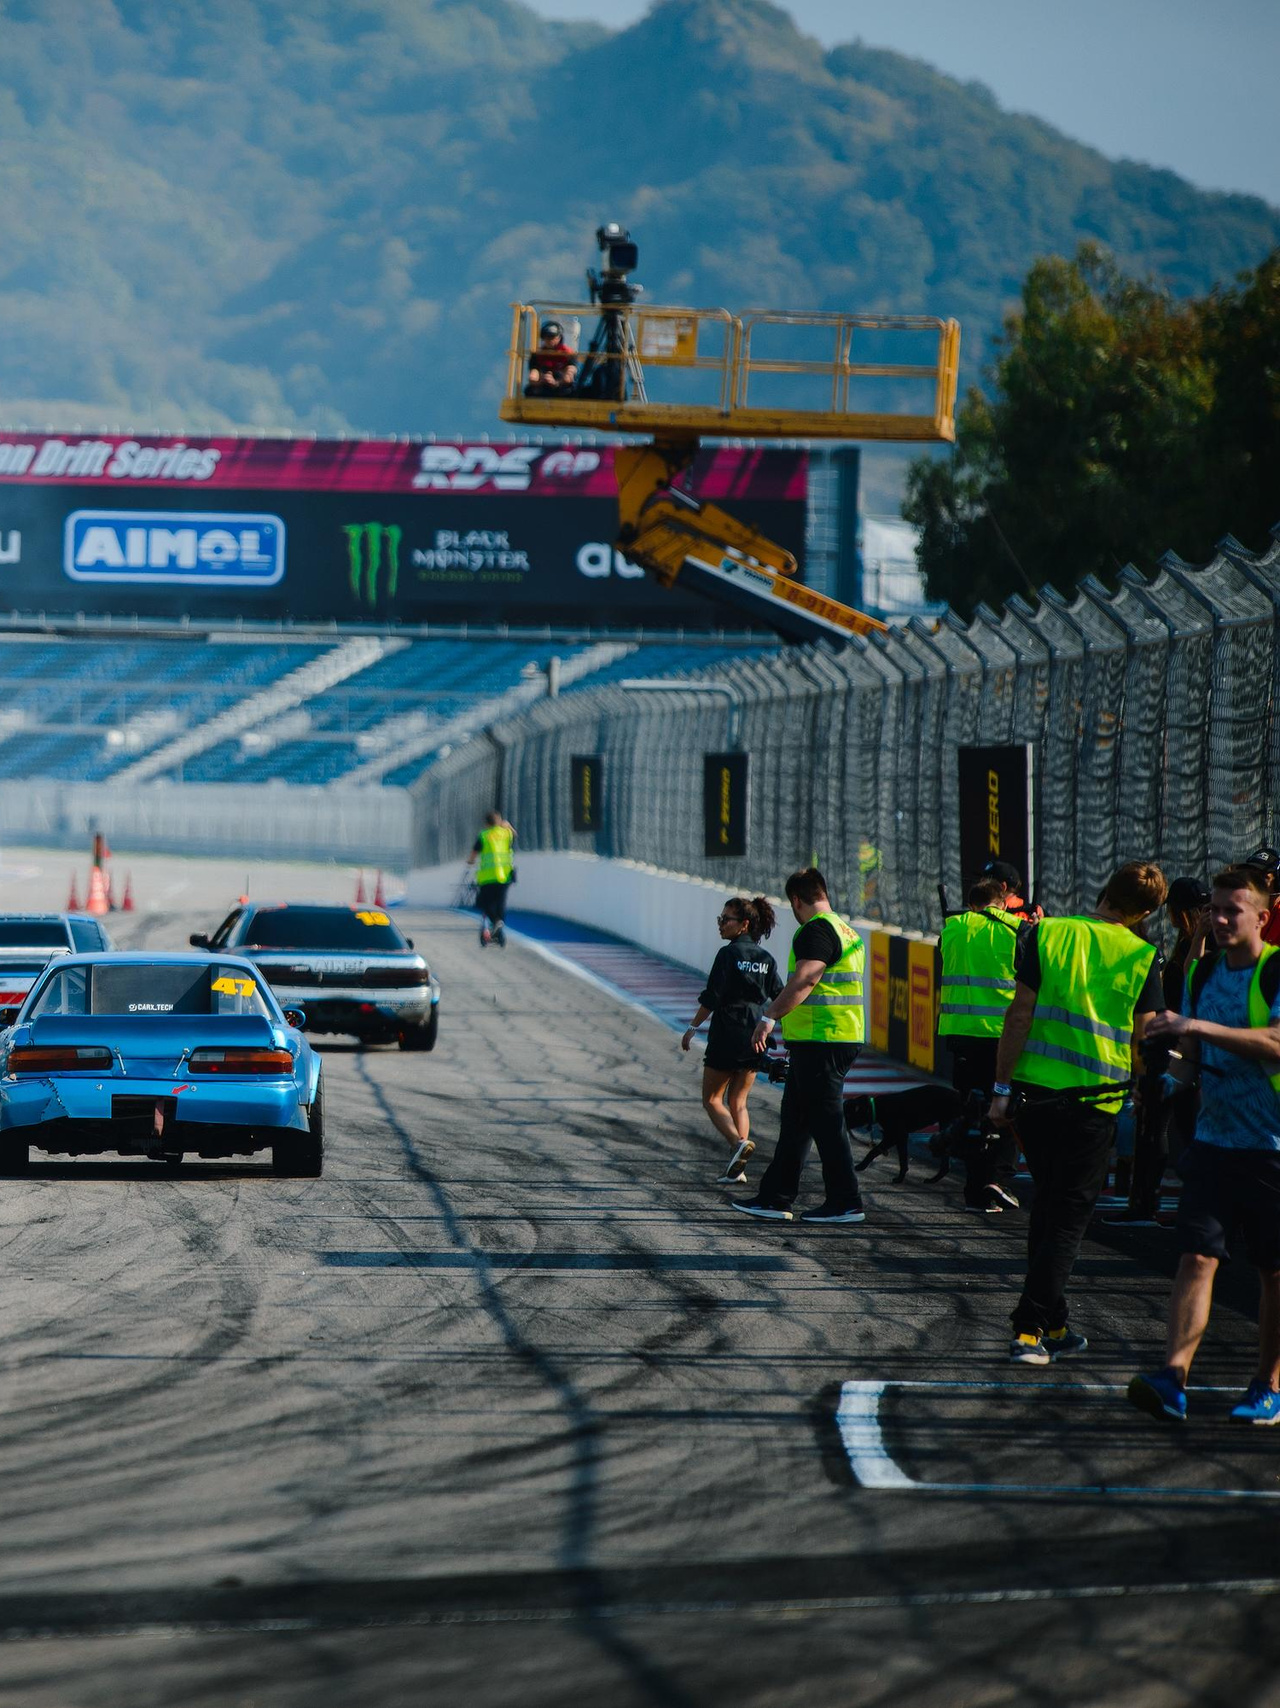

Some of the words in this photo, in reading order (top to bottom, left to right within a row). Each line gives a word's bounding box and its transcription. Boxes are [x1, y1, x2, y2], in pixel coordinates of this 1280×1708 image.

[31, 441, 111, 477] Drift
[108, 442, 221, 480] Series
[76, 526, 272, 570] AIMOL
[988, 769, 1000, 857] ZERO
[211, 977, 257, 998] 47
[138, 1003, 174, 1012] CARX_TECH
